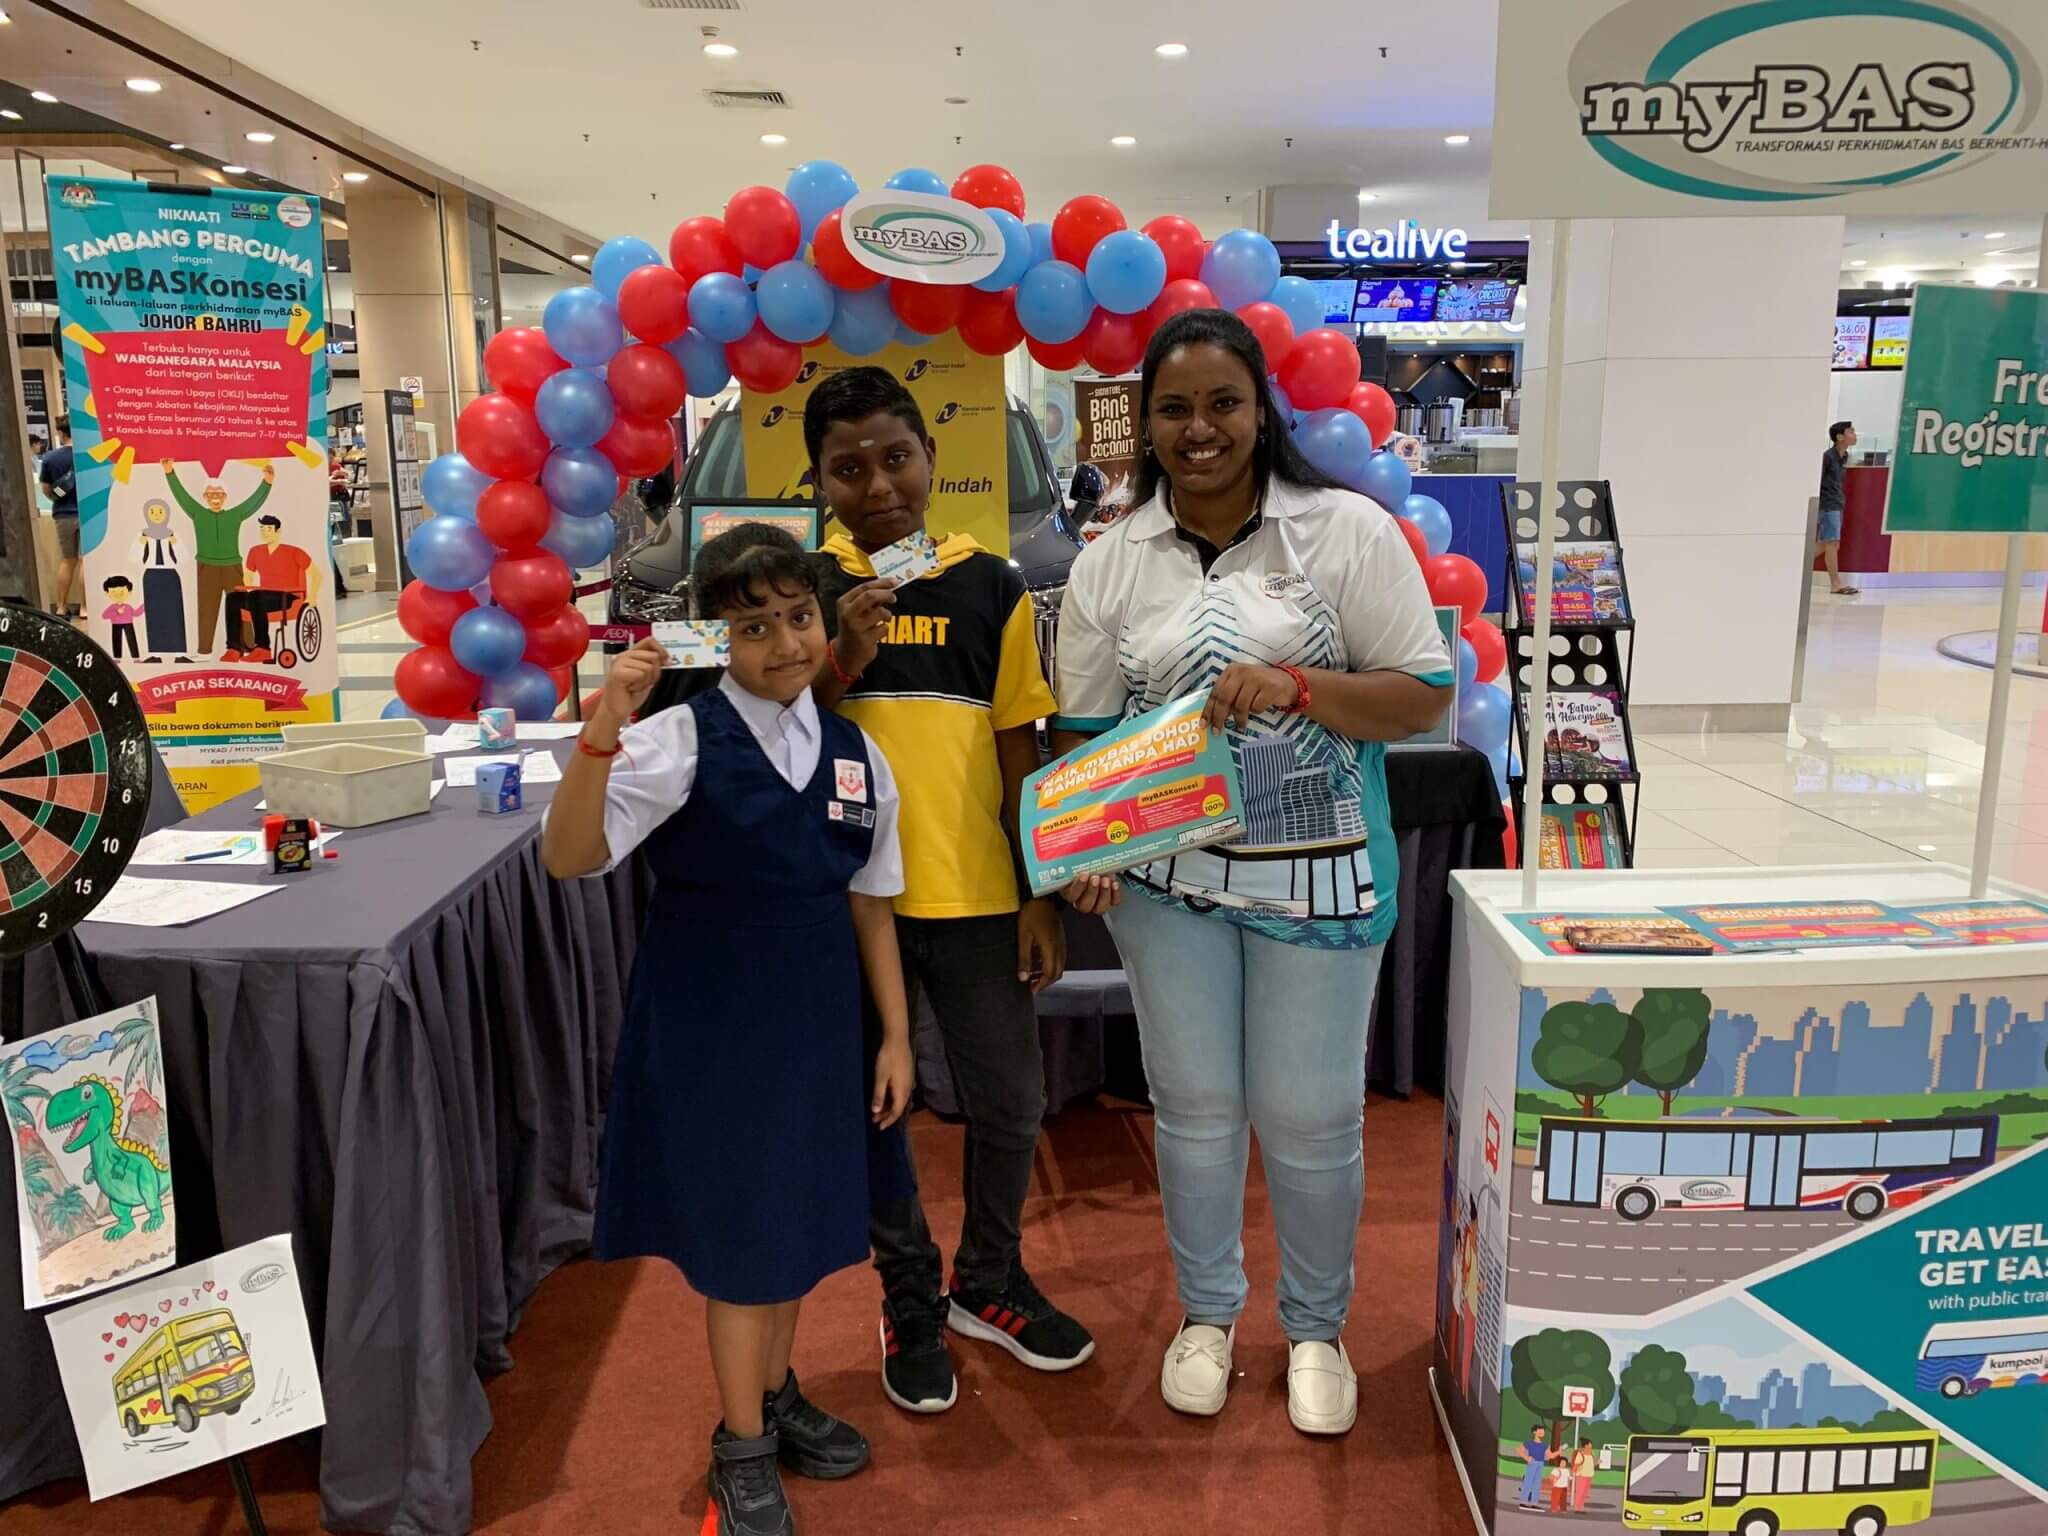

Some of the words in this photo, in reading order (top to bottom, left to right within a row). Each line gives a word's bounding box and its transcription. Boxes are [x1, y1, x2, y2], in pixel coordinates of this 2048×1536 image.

[1582, 62, 1975, 153] myBAS
[1736, 140, 1834, 152] TRANSFORMASI
[1837, 138, 1938, 151] PERKHIDMATAN
[1941, 138, 1964, 150] BAS
[158, 207, 220, 223] NIKMATI
[854, 226, 967, 252] myBAS
[1326, 219, 1468, 259] tealive
[63, 228, 190, 263] TAMBANG
[197, 229, 313, 279] PERCUMA
[171, 253, 213, 266] dengan
[75, 267, 307, 302] myBASKonsesi
[85, 297, 97, 306] di
[100, 298, 178, 311] laluan-laluan
[181, 301, 261, 316] perkhidmatan
[263, 307, 302, 319] myBAS
[139, 313, 197, 330] JOHOR
[203, 317, 262, 334] BAHRU
[143, 342, 183, 354] Terbuka
[187, 344, 220, 357] hanya
[222, 346, 251, 357] untuk
[115, 354, 217, 368] WARGANEGARA
[218, 358, 281, 370] MALAYSIA
[145, 368, 166, 378] dari
[168, 368, 213, 381] kategori
[113, 385, 143, 397] Orang
[145, 387, 184, 396] Kelainan
[185, 388, 215, 399] Upaya
[117, 400, 152, 410] dengan
[155, 400, 191, 409] Jabatan
[194, 402, 237, 413] Kebajikan
[240, 404, 290, 414] Masyarakat
[1090, 394, 1129, 421] BANG
[114, 412, 146, 423] Warga
[148, 413, 172, 422] Emas
[175, 413, 211, 424] berumur
[214, 416, 225, 424] 60
[228, 416, 253, 425] tahun
[255, 417, 262, 425] &
[265, 417, 276, 426] ke
[278, 419, 297, 427] atas
[186, 428, 217, 438] Pelajar
[278, 431, 304, 440] tahun
[1093, 416, 1132, 442] BANG
[1090, 438, 1135, 457] COCONUT
[939, 477, 993, 494] Indah
[38, 626, 47, 641] 1
[75, 654, 94, 669] 18
[151, 679, 206, 698] DAFTAR
[208, 677, 288, 696] SEKARANG!
[107, 692, 119, 707] 4
[148, 723, 168, 731] Sila
[170, 723, 200, 731] bawa
[202, 722, 254, 730] dokumen
[119, 740, 138, 754] 13
[1044, 766, 1083, 788] NAIK
[1144, 718, 1201, 744] JOHOR
[1044, 770, 1098, 798] BAHRU
[1102, 748, 1158, 773] TANPA
[1162, 733, 1201, 754] HAD
[121, 789, 132, 804] 6
[102, 838, 120, 854] 10
[74, 880, 93, 895] 15
[37, 913, 48, 928] 2
[1920, 1259, 1990, 1287] GET
[1928, 1294, 1965, 1310] with
[1968, 1290, 2020, 1311] public
[1989, 1355, 2044, 1370] kumpool
